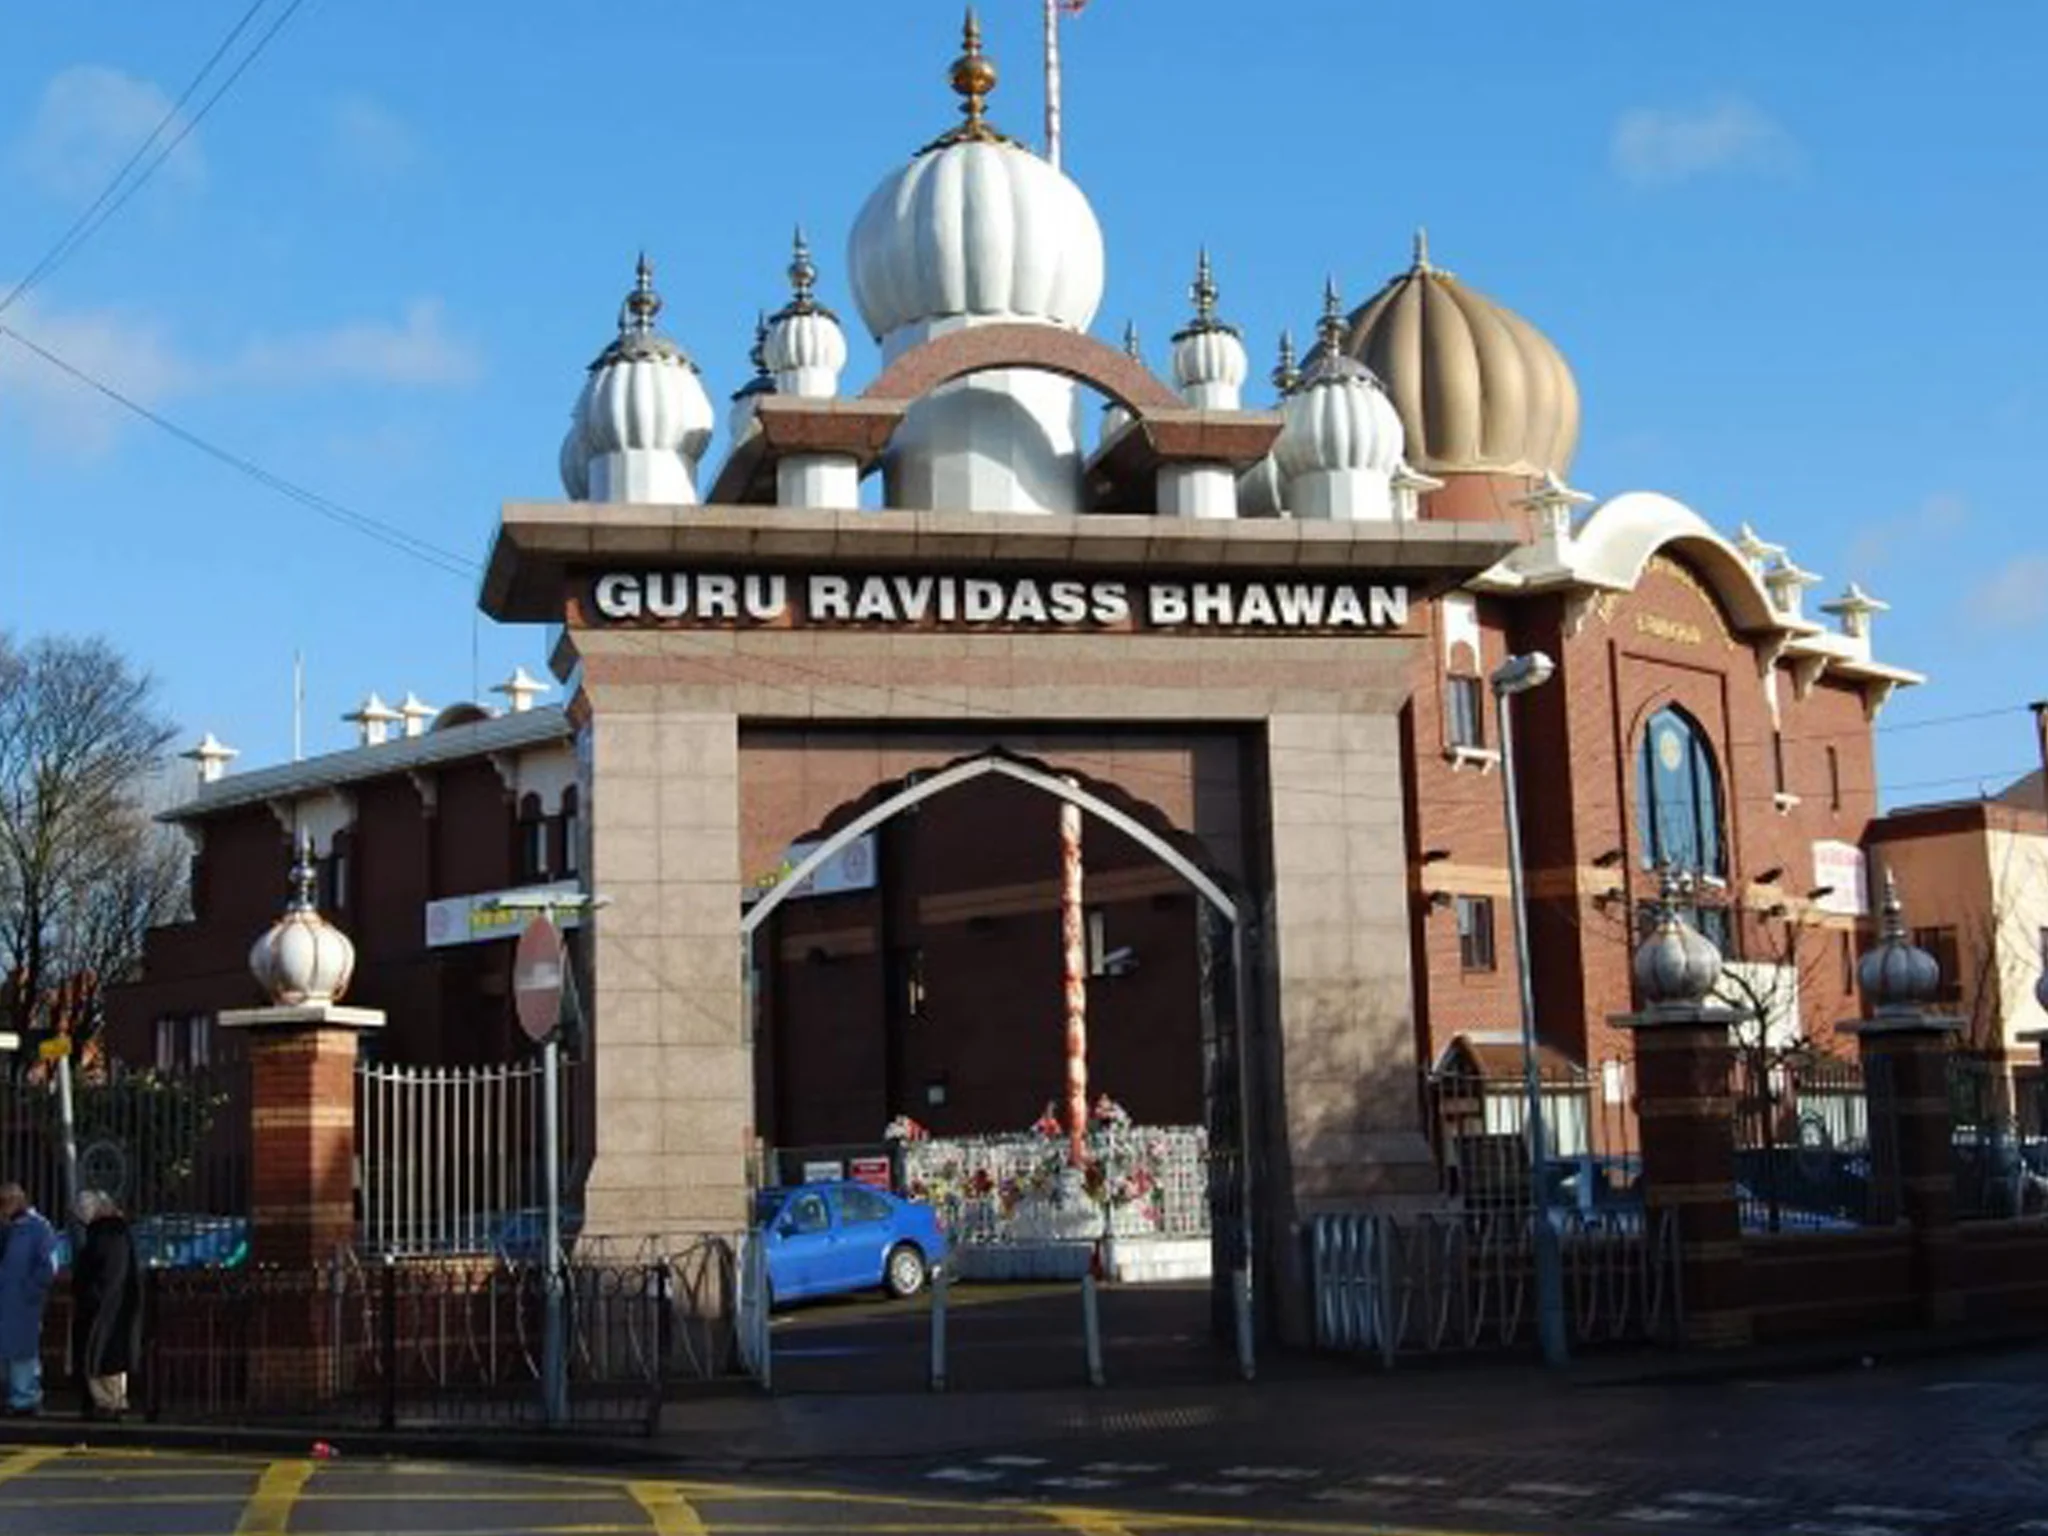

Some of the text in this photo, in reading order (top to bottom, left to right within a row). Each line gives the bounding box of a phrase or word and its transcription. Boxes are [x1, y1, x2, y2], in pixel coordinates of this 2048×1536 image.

[596, 573, 1408, 626] GURU RAVIDASS BHAWAN
